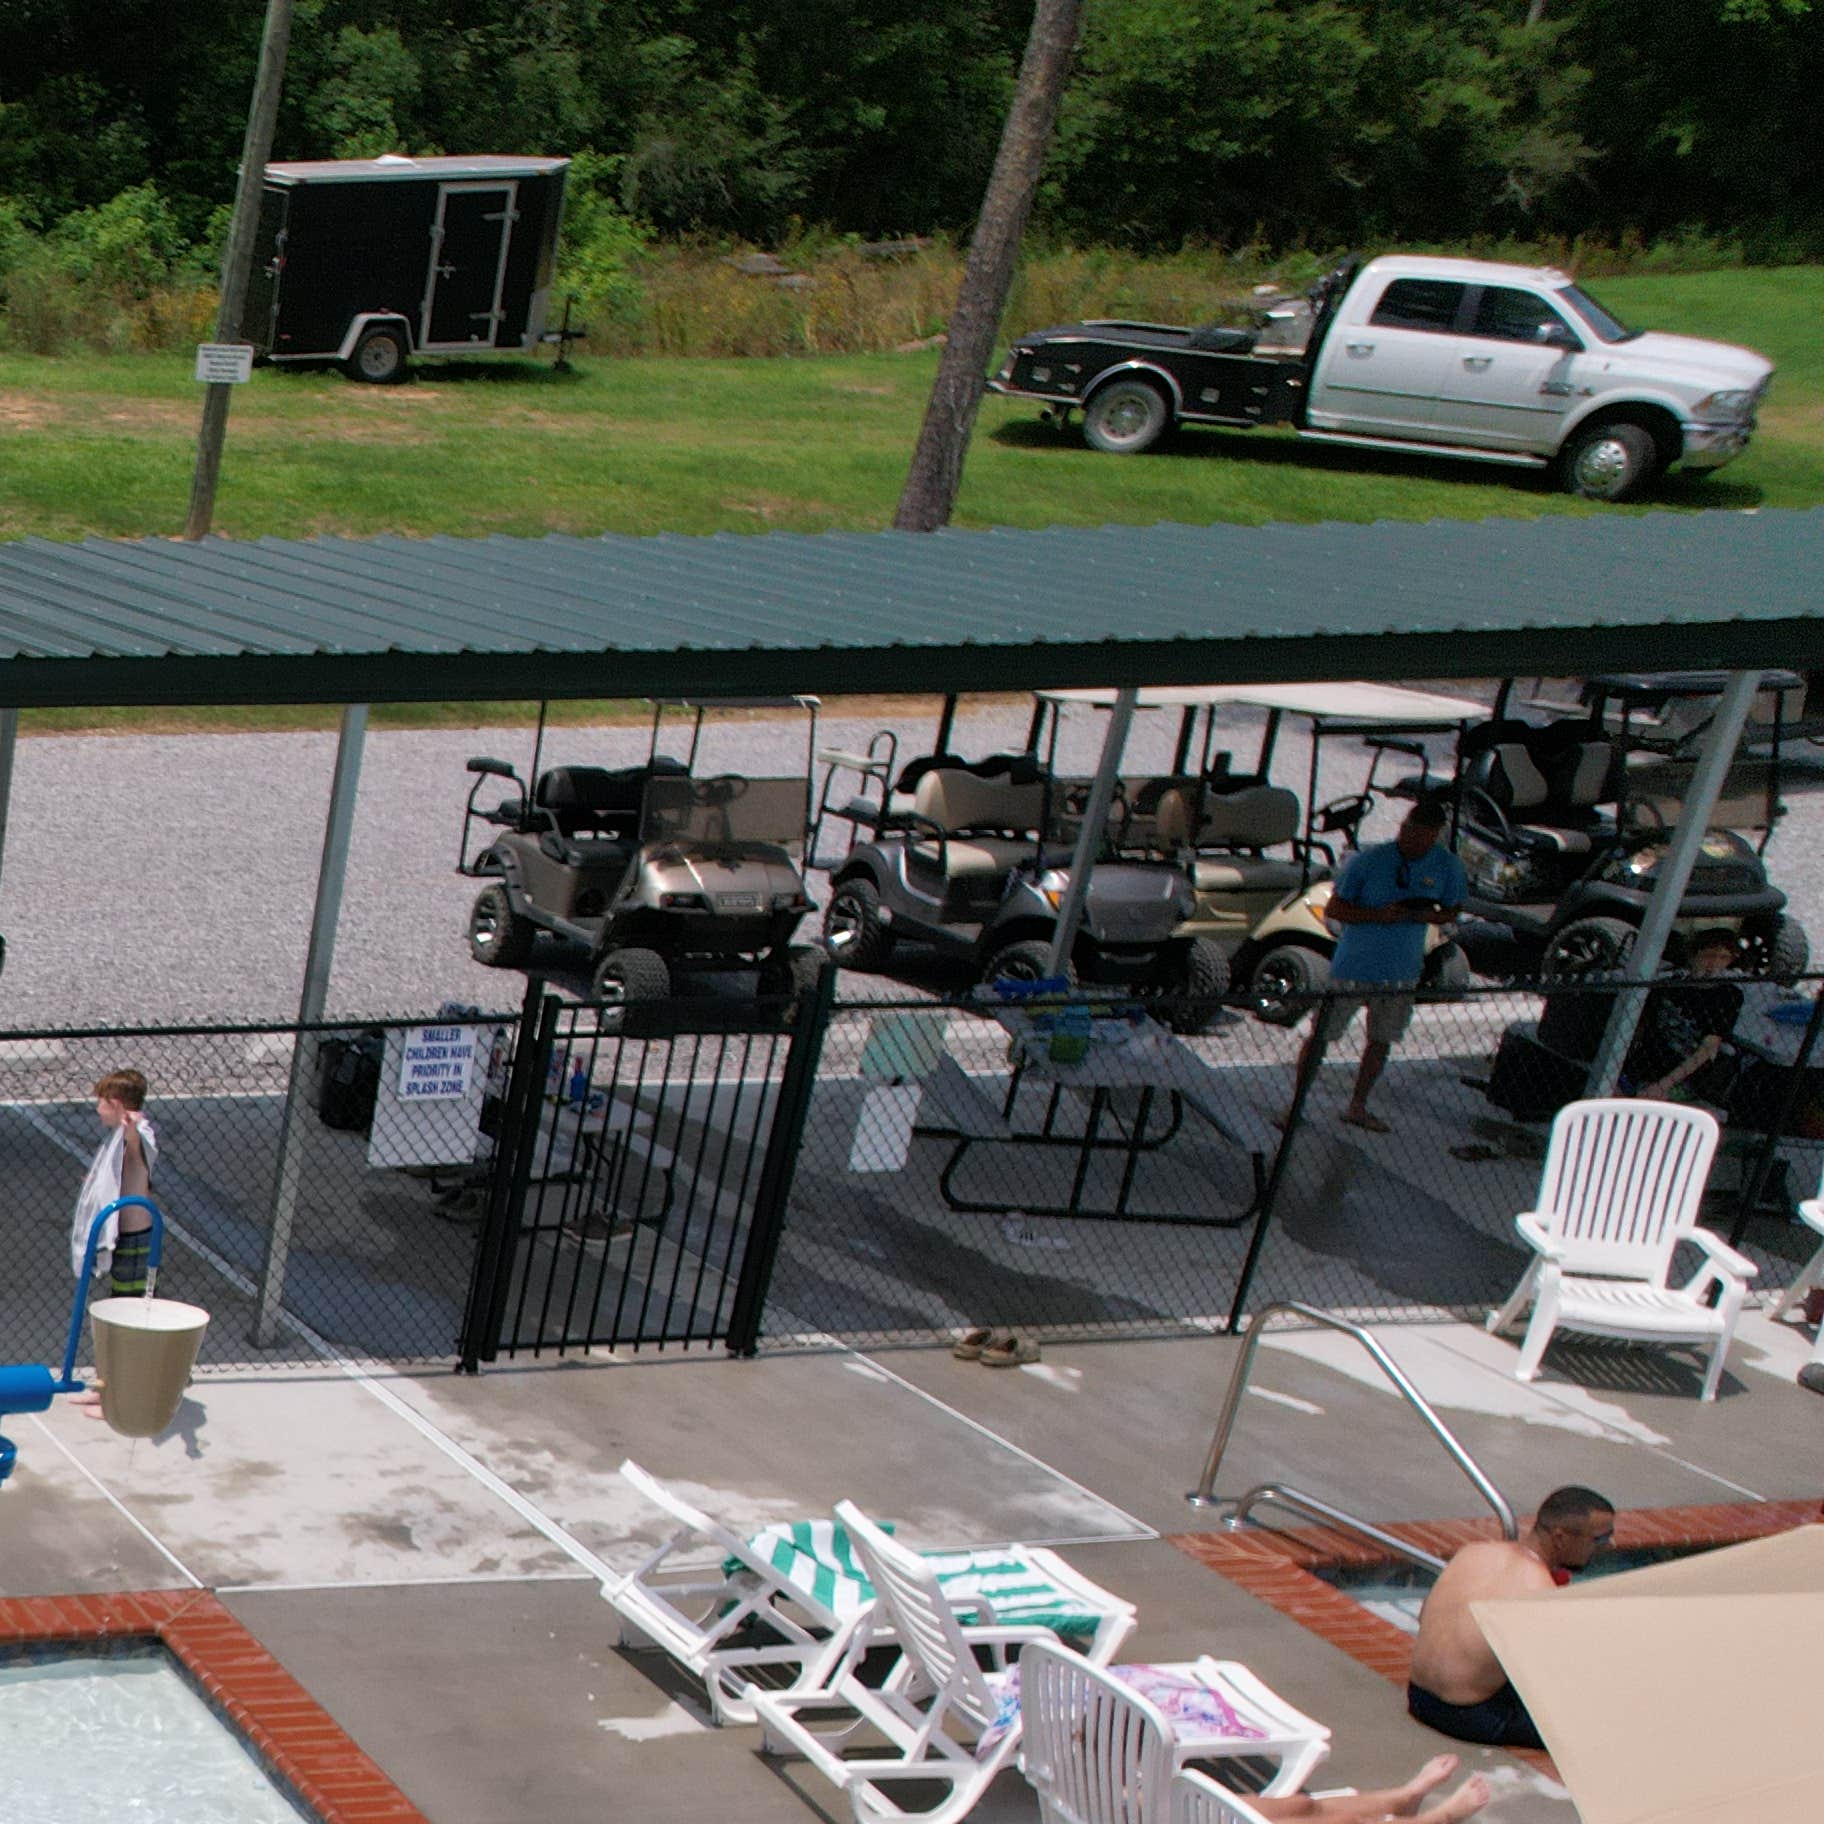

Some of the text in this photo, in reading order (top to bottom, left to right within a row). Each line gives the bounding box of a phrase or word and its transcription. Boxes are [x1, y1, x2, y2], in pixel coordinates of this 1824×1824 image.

[423, 1028, 461, 1043] SMALLER
[406, 1045, 473, 1061] CHILDREN HAVE
[412, 1063, 462, 1078] PRIORITY IN
[406, 1080, 463, 1096] SPLASH ZONE
